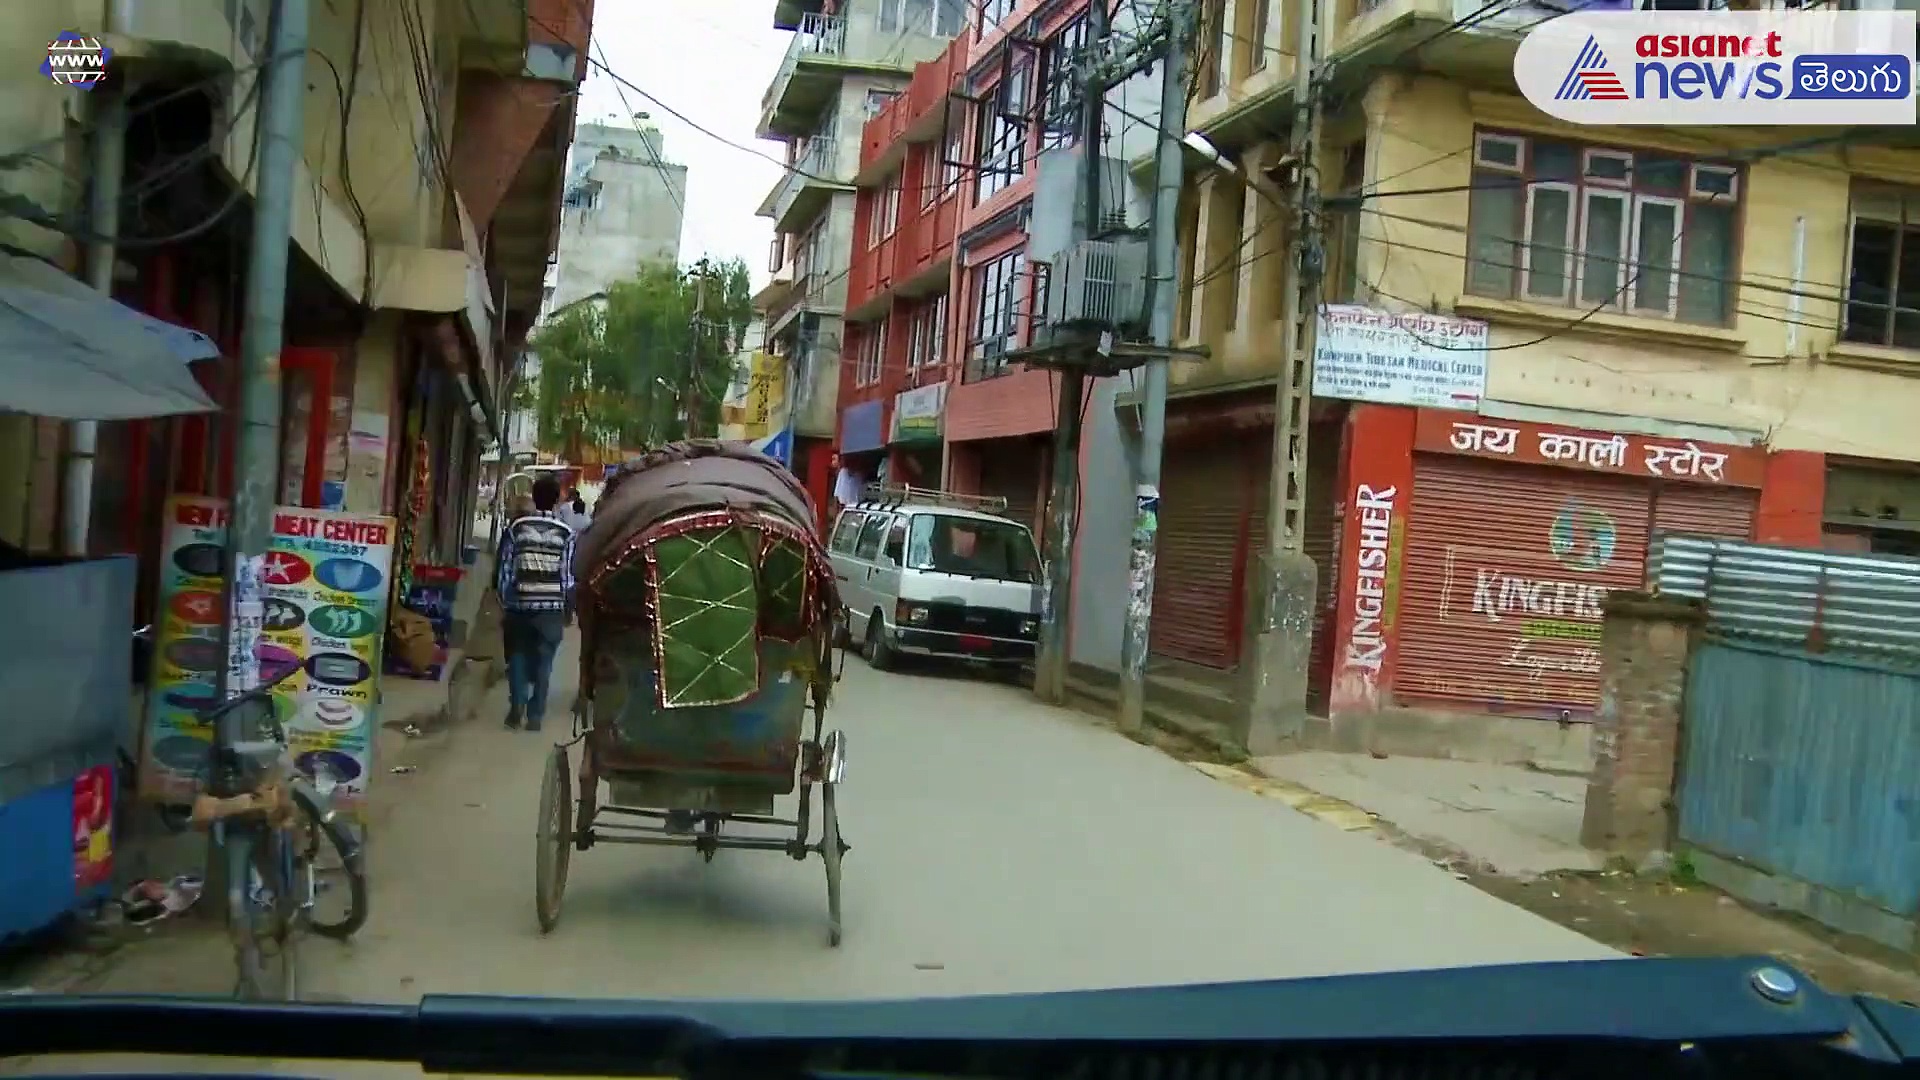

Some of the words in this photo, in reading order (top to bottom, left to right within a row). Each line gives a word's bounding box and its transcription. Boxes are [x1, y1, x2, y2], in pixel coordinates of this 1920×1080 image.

[1366, 352, 1405, 367] TIBETAN
[1407, 356, 1449, 373] MEDICAL
[1450, 422, 1520, 454] जय
[1537, 432, 1629, 467] काली
[1643, 442, 1729, 482] स्टोर
[323, 519, 388, 545] CENTER
[1343, 484, 1397, 681] KINGFISHER
[305, 683, 367, 699] Prawn
